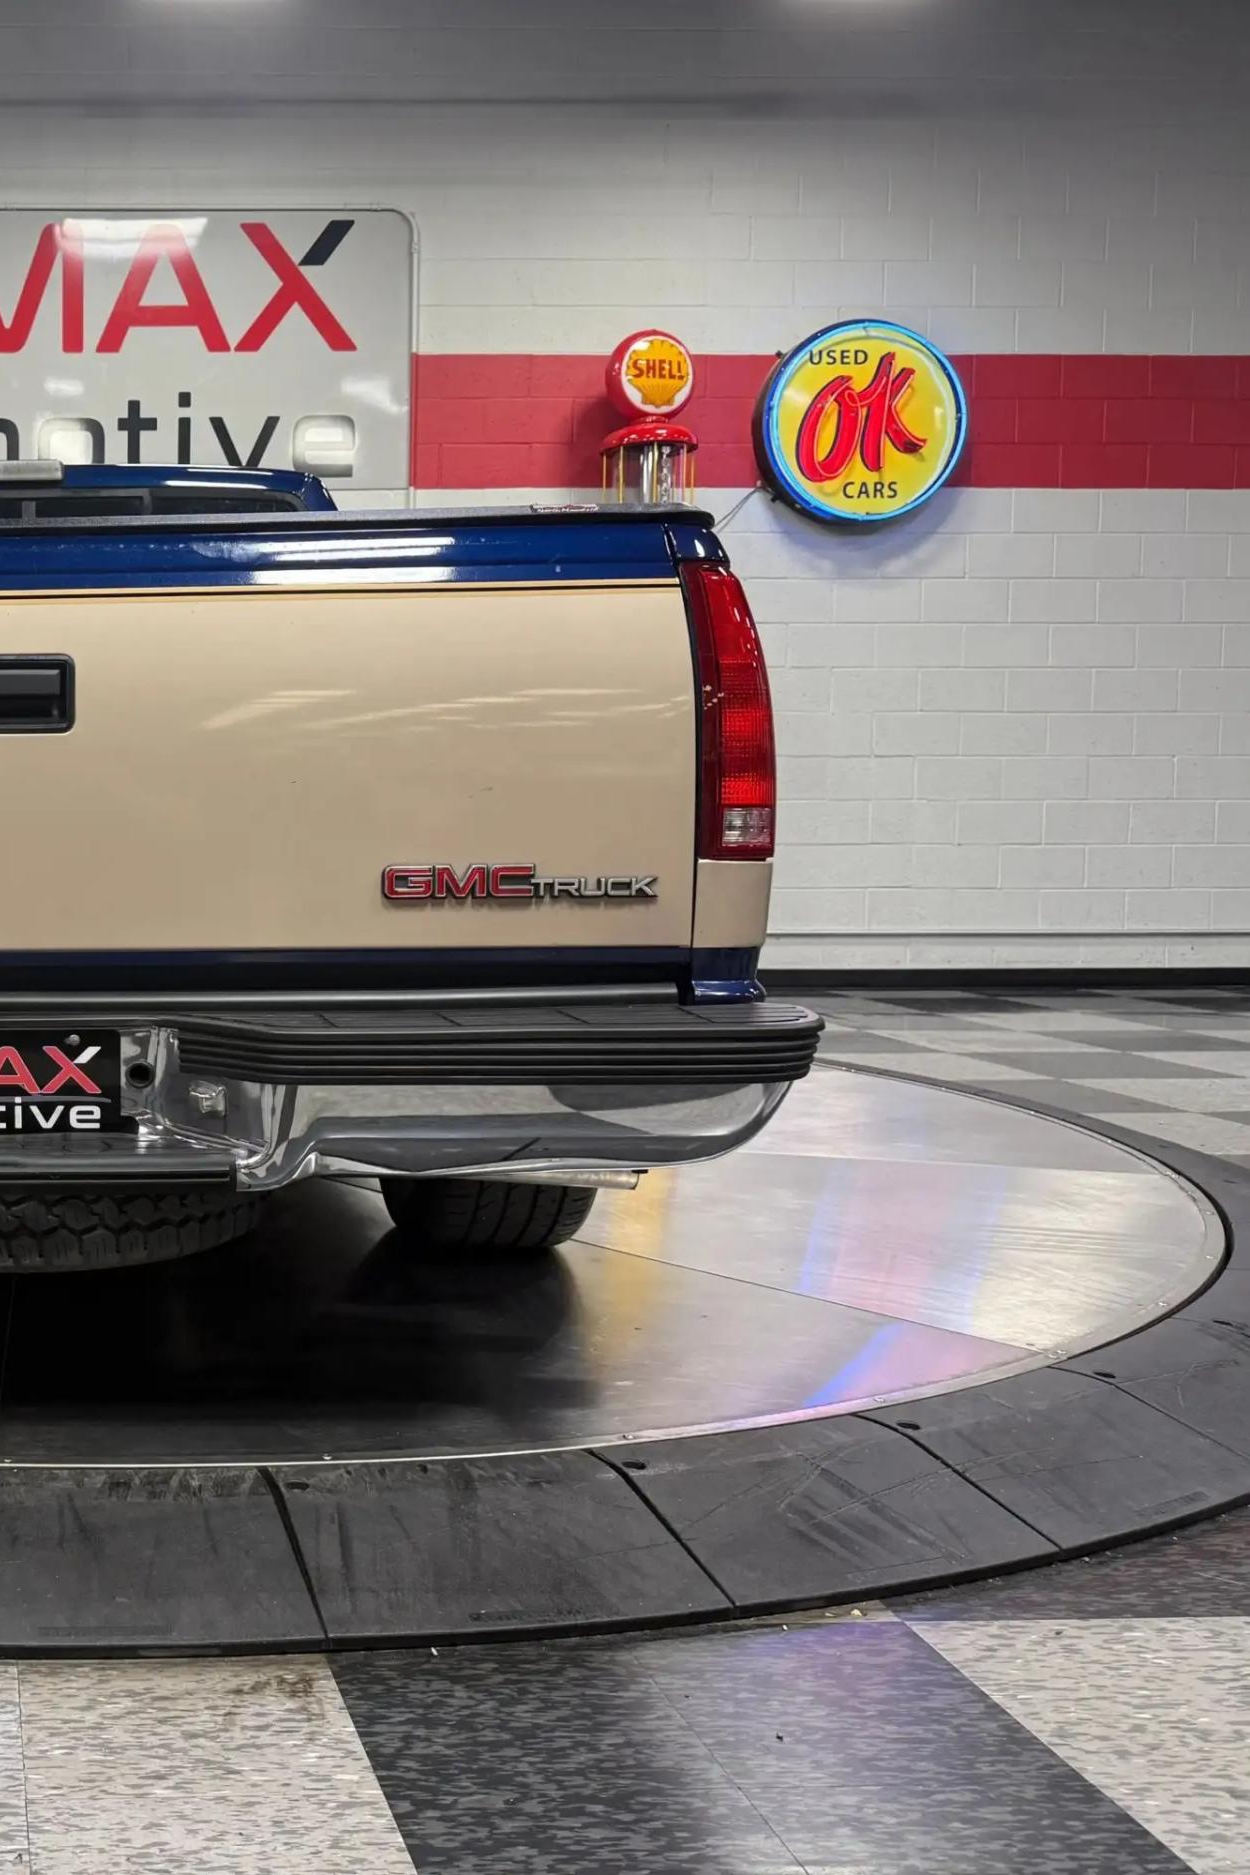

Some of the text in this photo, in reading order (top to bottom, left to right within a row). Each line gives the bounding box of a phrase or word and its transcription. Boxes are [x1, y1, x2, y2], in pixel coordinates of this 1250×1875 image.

[809, 349, 869, 366] USED
[631, 358, 686, 382] SHELL
[795, 351, 928, 483] OK
[842, 481, 899, 499] CARS
[382, 864, 659, 899] GMC TRUCK
